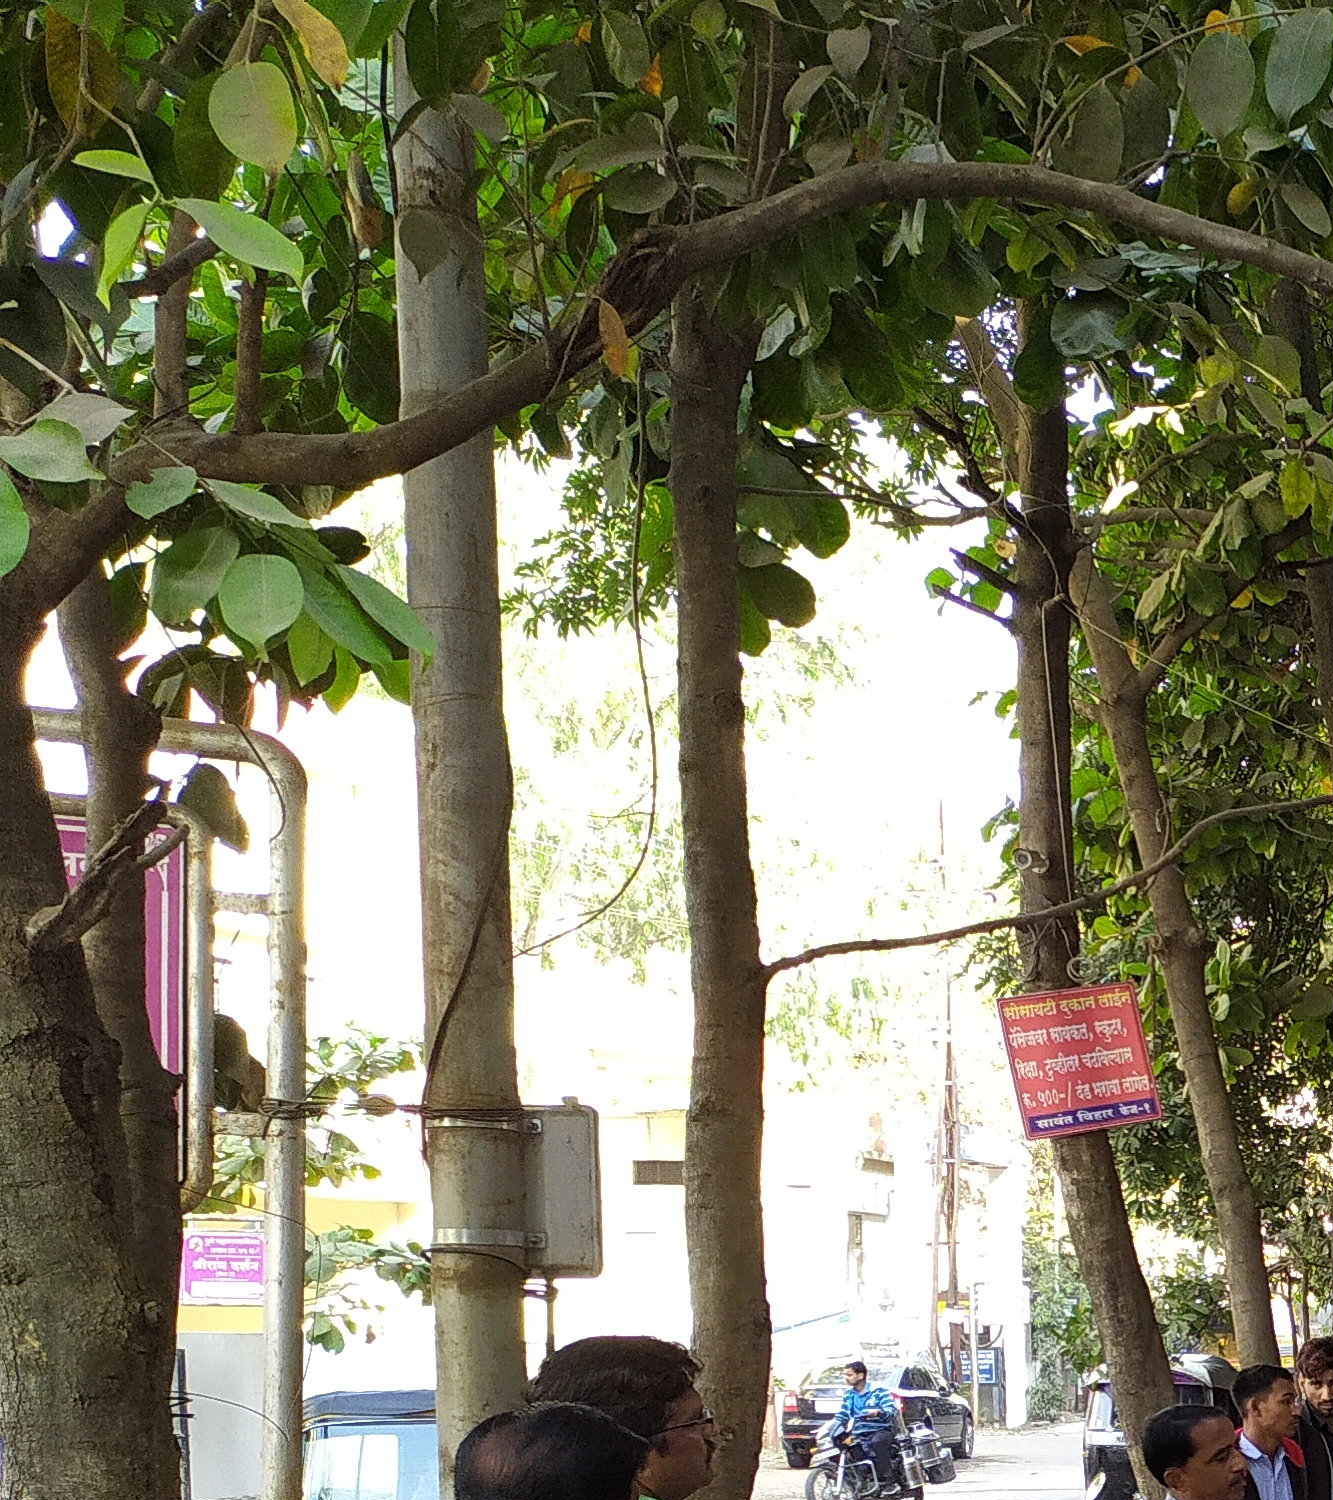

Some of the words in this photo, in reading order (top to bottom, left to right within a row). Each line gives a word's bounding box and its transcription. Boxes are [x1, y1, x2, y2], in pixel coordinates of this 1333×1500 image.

[1003, 998, 1057, 1021] सोसायटी
[1059, 996, 1096, 1018] दुकान
[1035, 1114, 1073, 1129] सावंत
[1077, 1108, 1114, 1123] विहार
